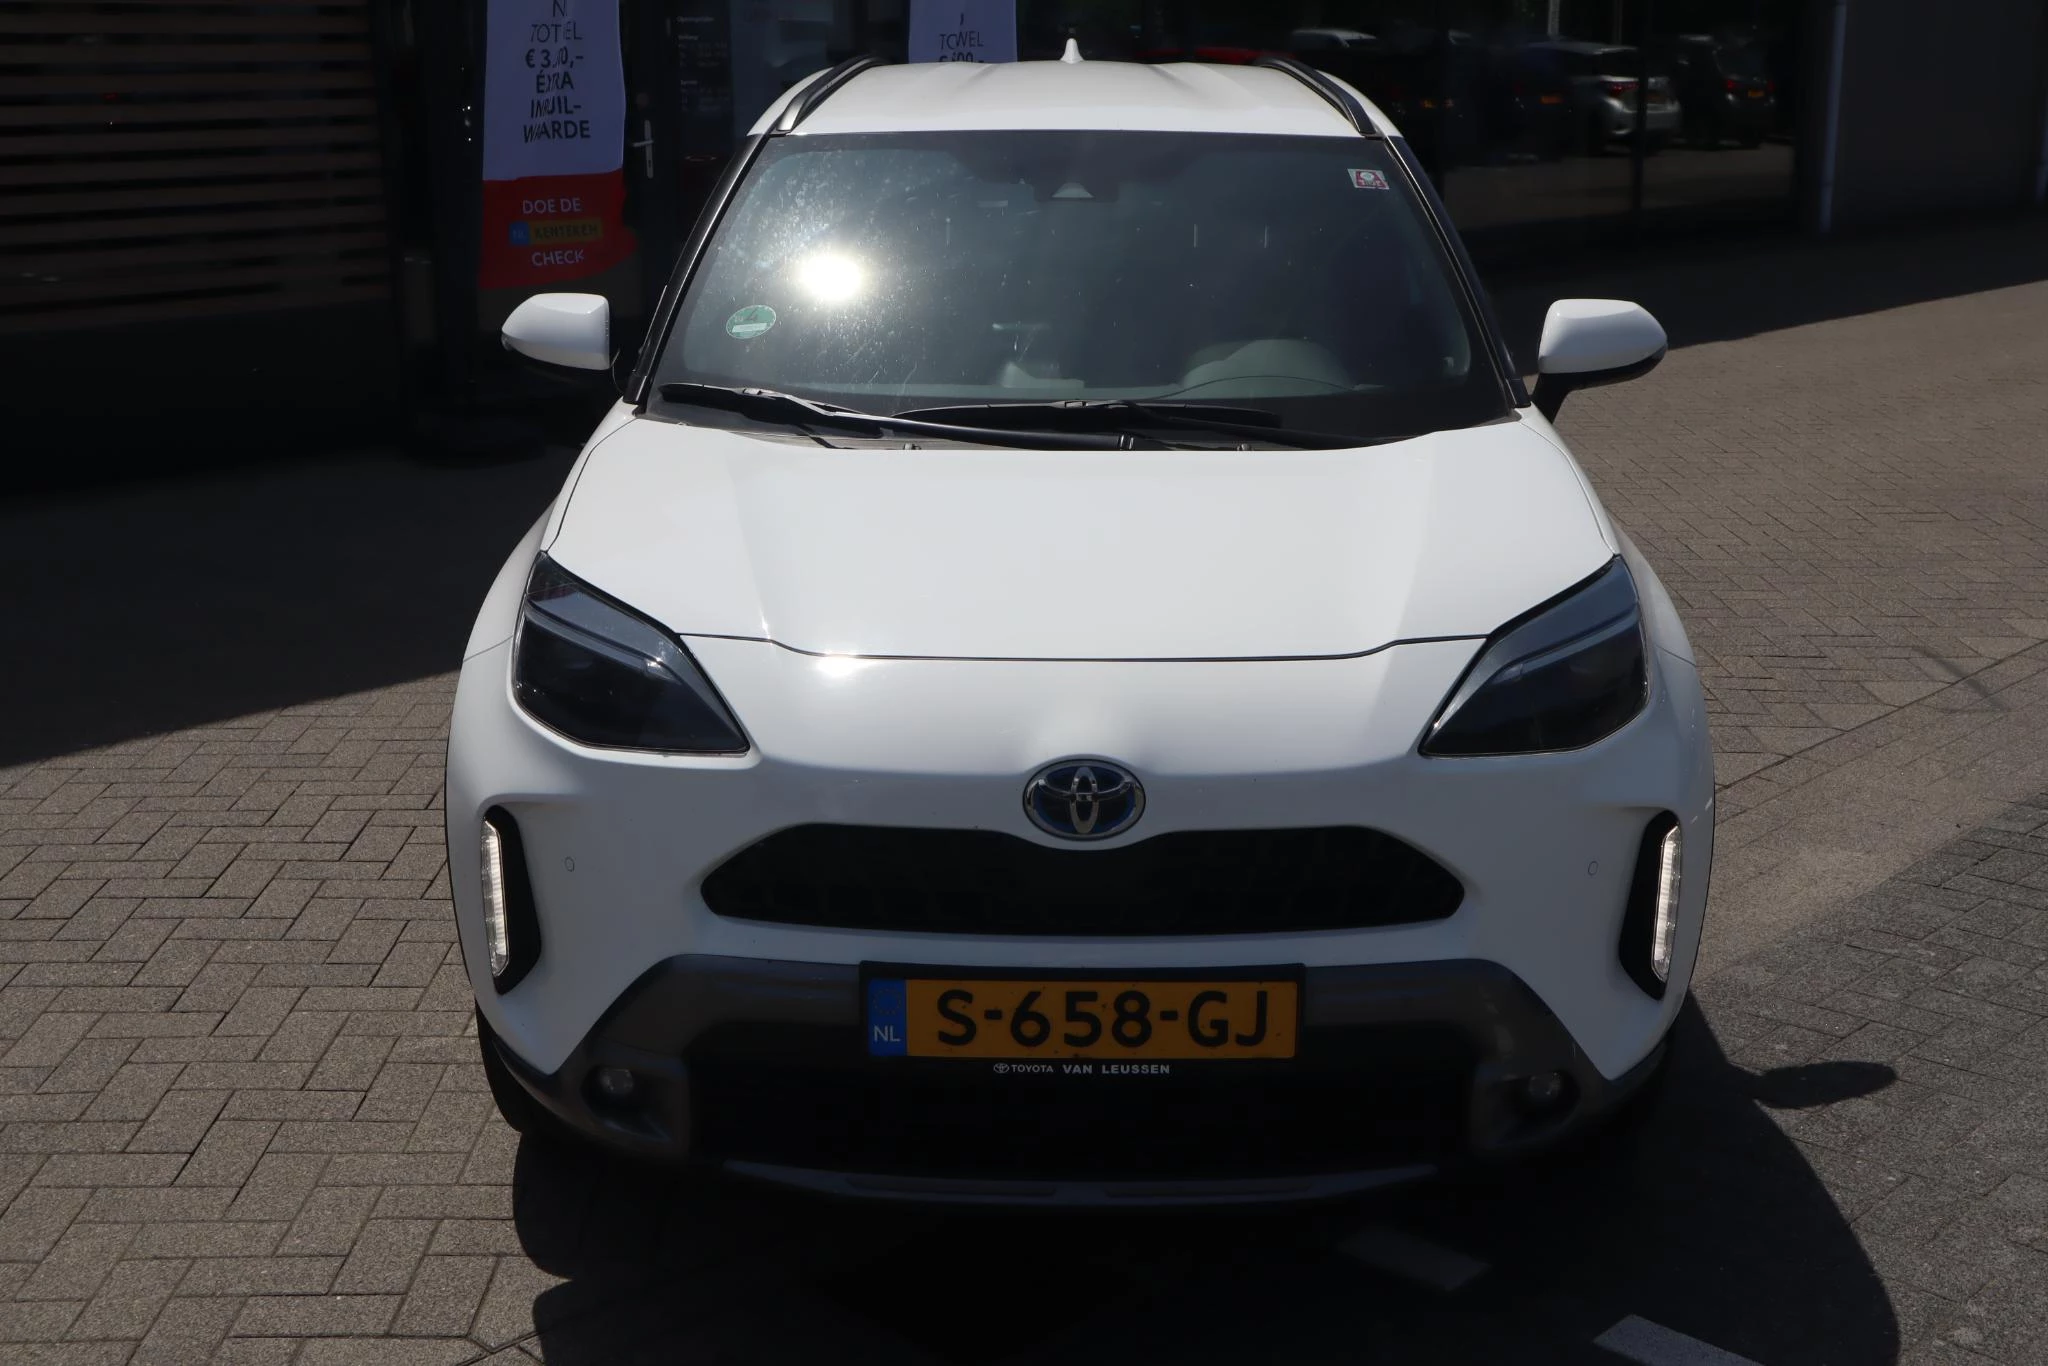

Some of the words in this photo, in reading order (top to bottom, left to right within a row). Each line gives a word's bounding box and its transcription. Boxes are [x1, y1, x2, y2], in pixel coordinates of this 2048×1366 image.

[522, 198, 557, 214] DOE
[560, 197, 583, 212] DE
[532, 249, 584, 267] CHECK
[873, 1025, 900, 1042] NL
[937, 989, 1268, 1048] S-658-GJ
[1011, 1064, 1054, 1073] TOYOTA
[1063, 1064, 1093, 1074] VAN
[1102, 1064, 1170, 1074] LEUSSEN
